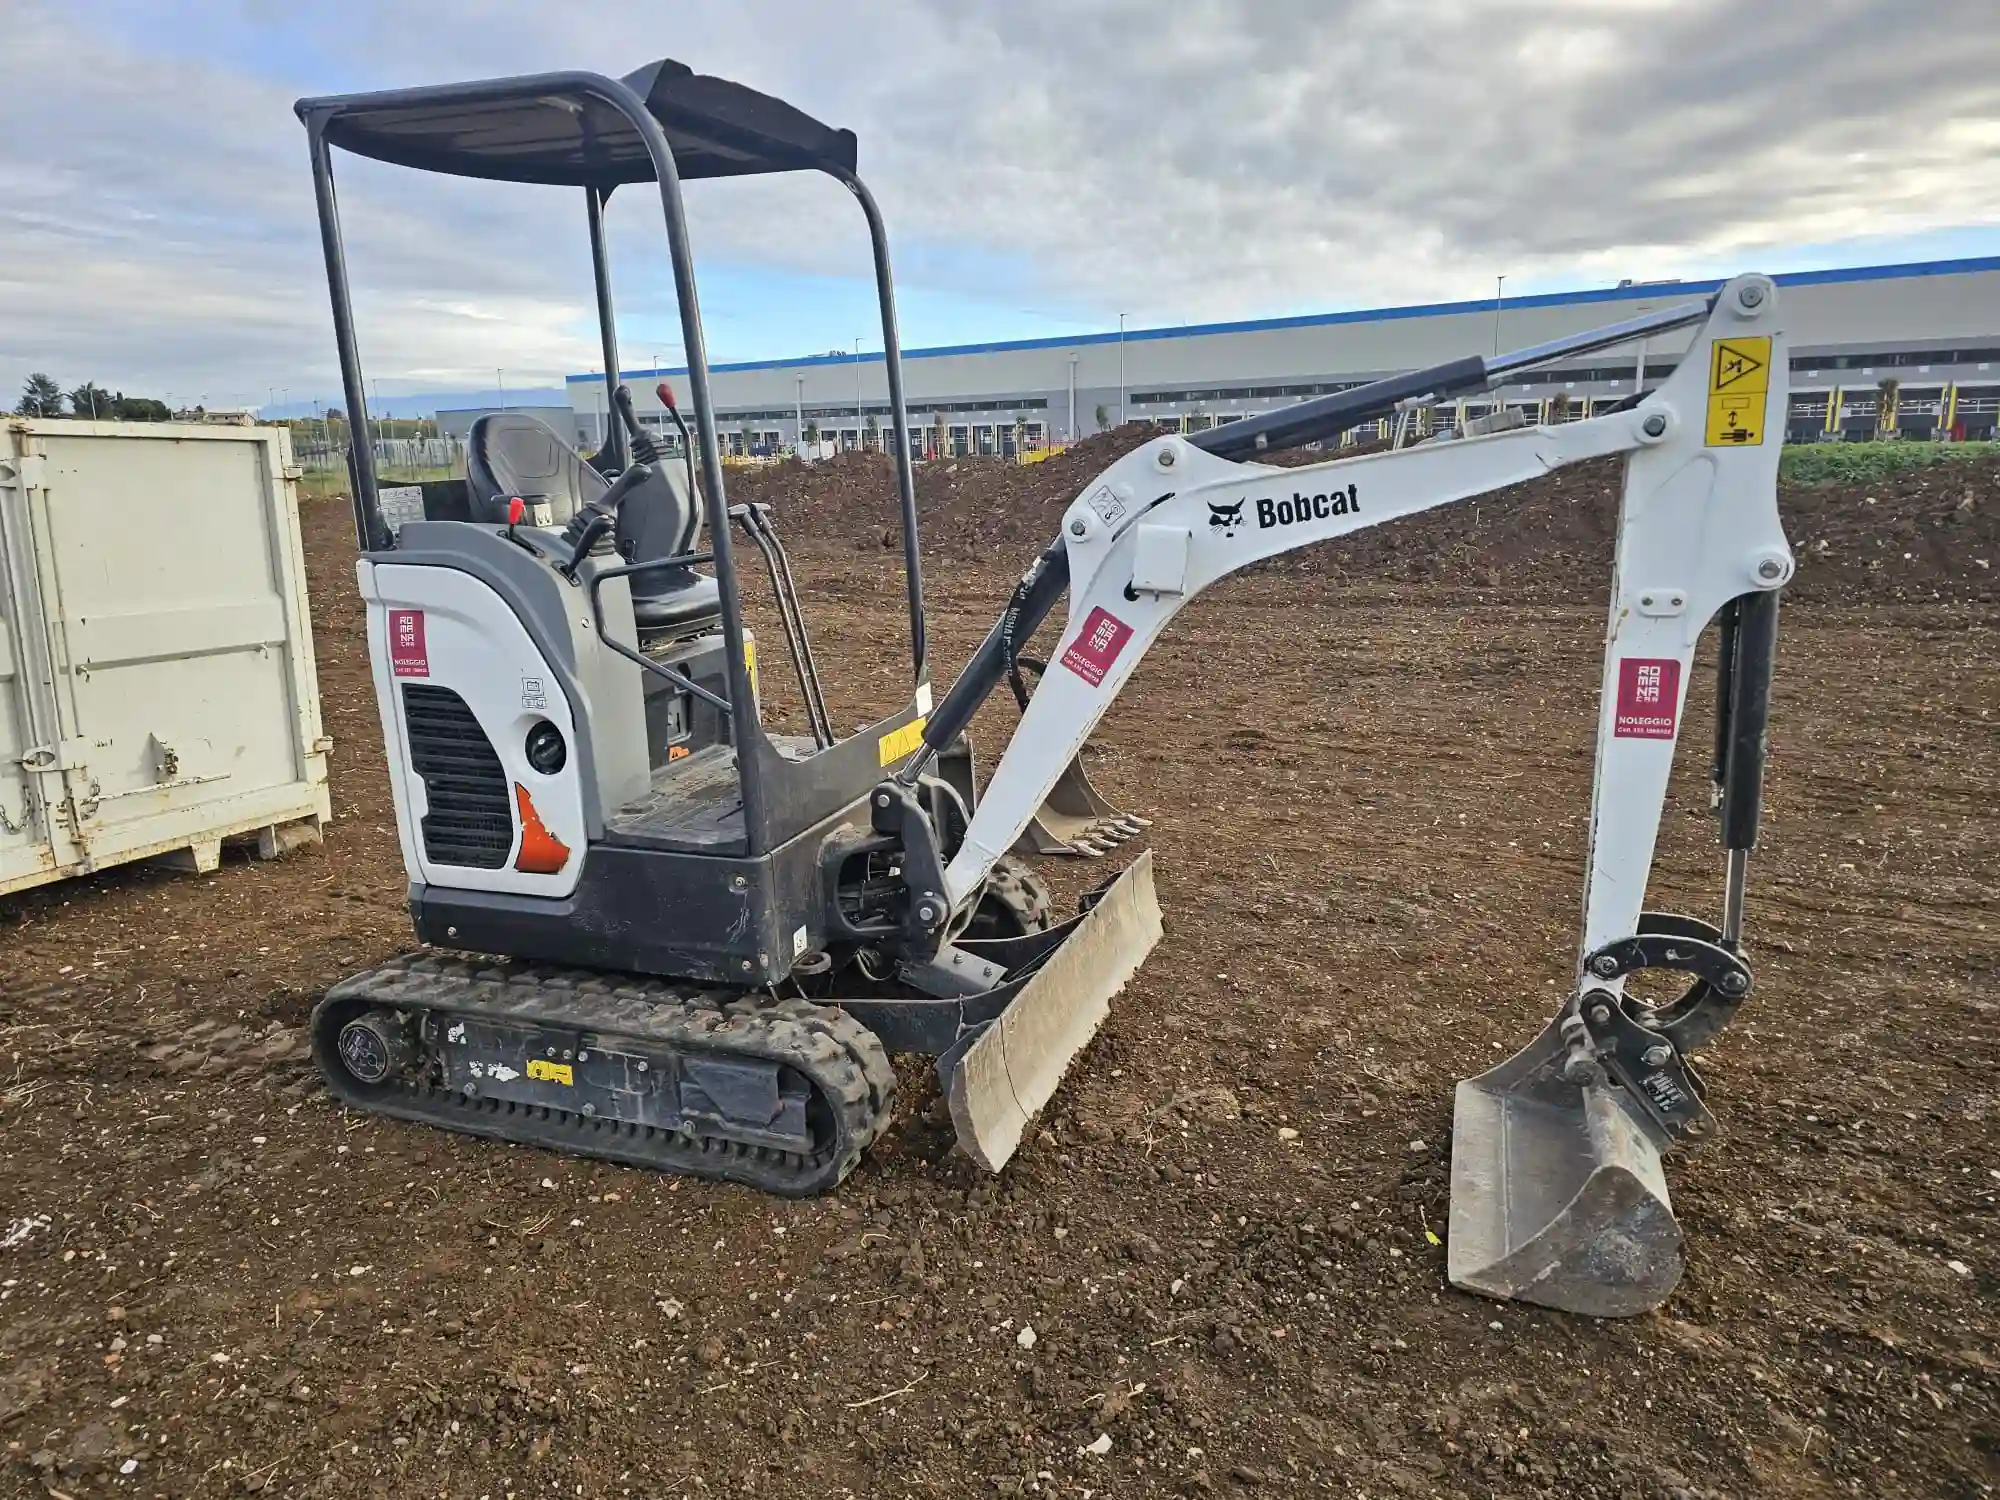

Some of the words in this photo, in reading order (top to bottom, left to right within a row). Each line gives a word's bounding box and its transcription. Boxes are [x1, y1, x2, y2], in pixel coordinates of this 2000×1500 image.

[1256, 484, 1360, 528] Bobcat
[1068, 649, 1104, 676] NOLEGGIO
[1618, 716, 1672, 726] NOLEGGIO
